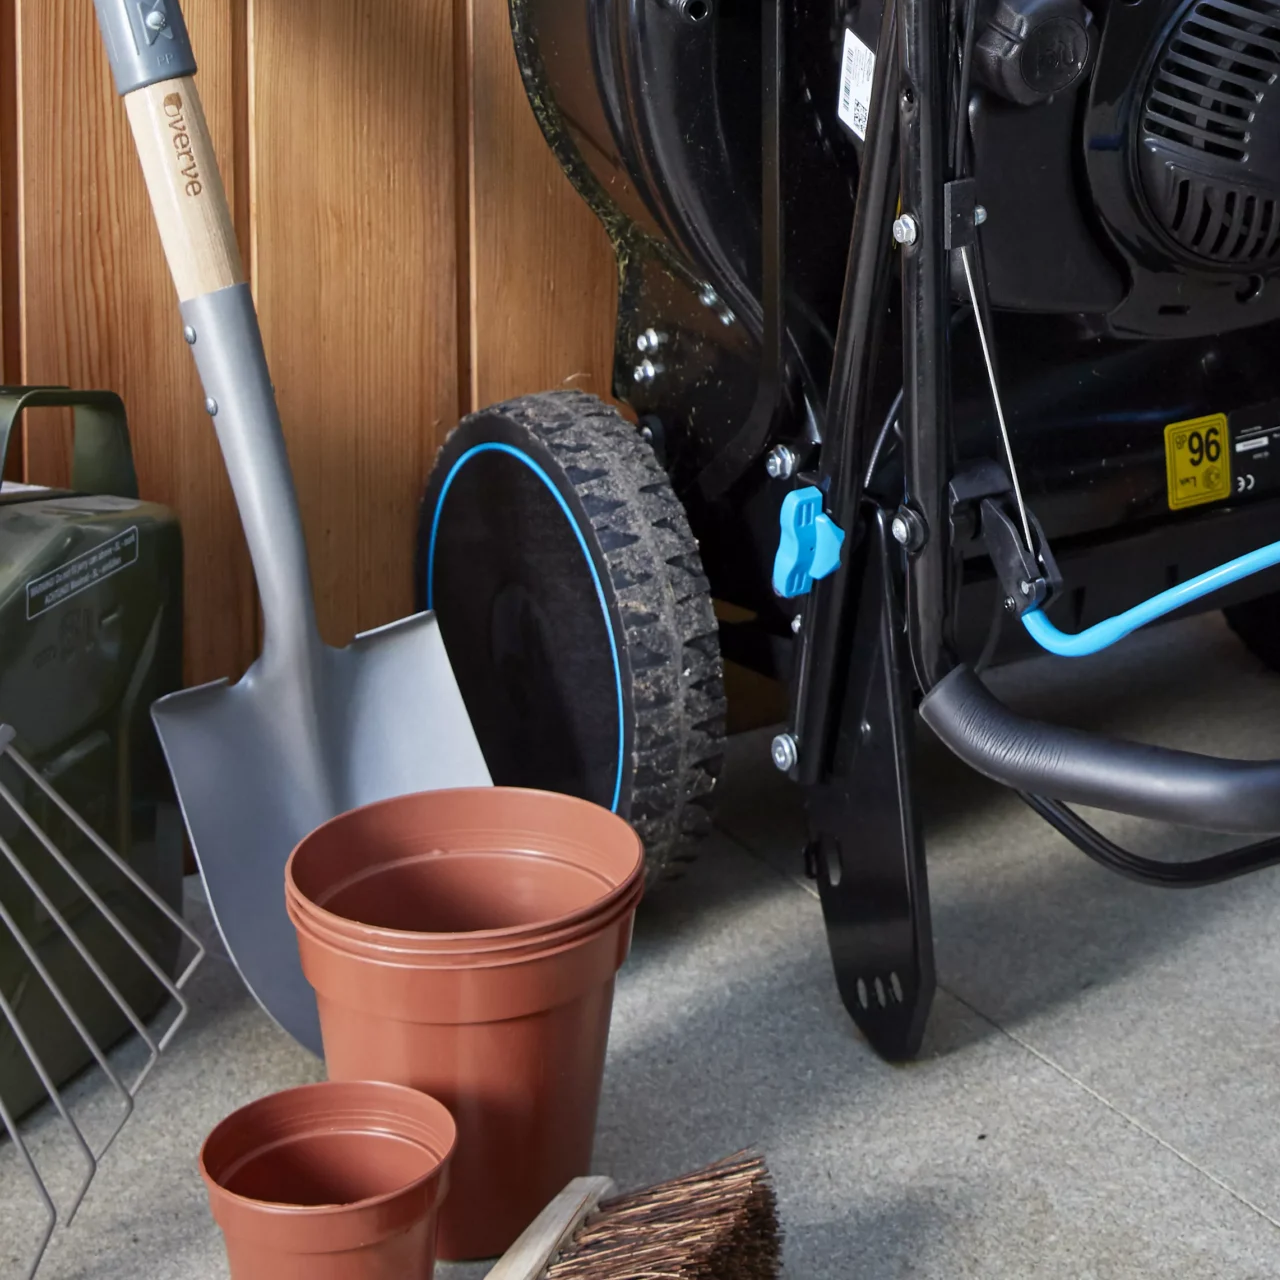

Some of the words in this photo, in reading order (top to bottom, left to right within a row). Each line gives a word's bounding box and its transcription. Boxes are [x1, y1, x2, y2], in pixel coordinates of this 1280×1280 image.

[169, 115, 202, 197] verve
[1175, 434, 1187, 450] dB
[1188, 427, 1221, 467] 96
